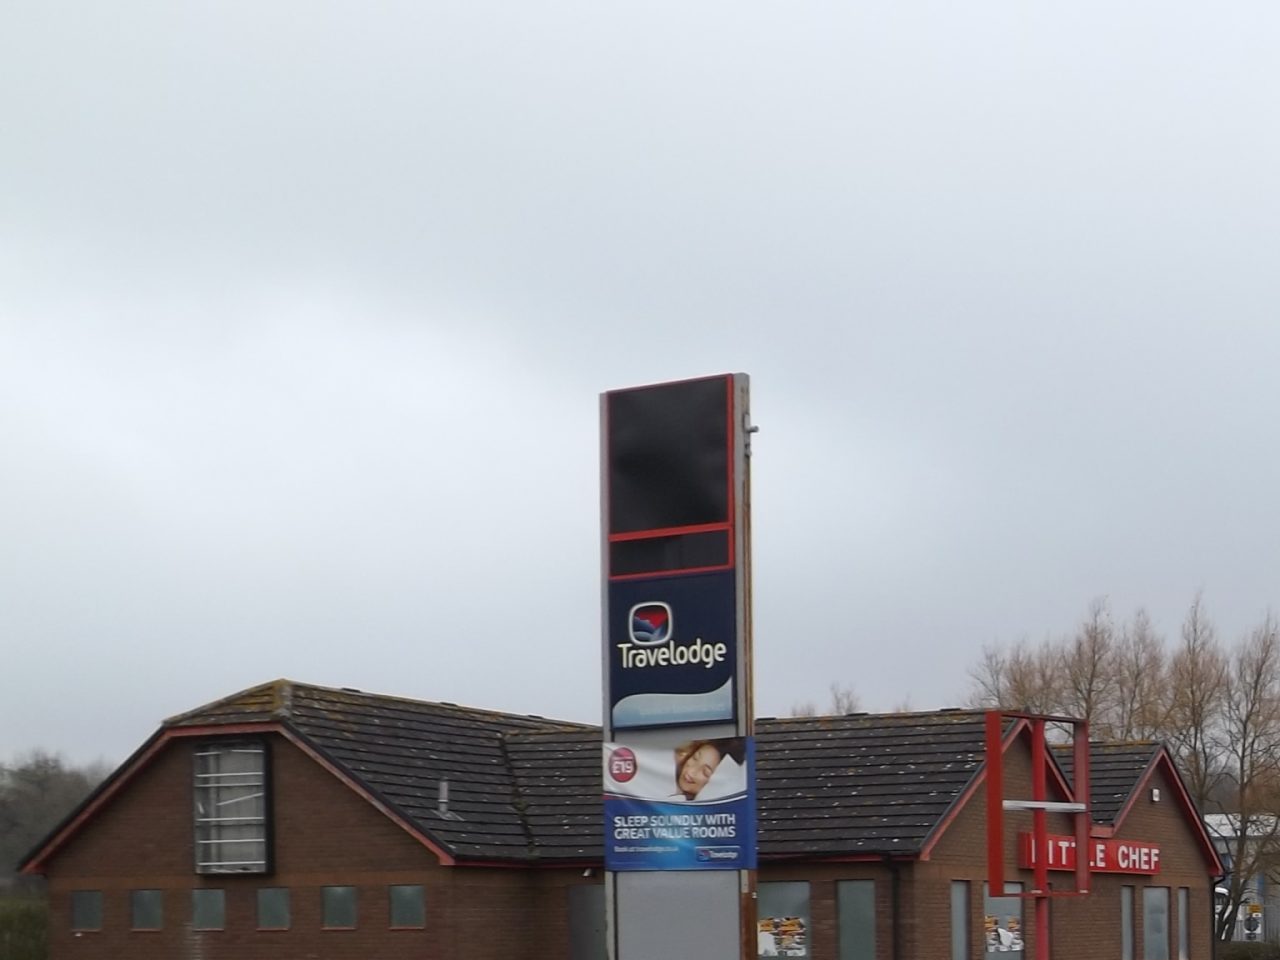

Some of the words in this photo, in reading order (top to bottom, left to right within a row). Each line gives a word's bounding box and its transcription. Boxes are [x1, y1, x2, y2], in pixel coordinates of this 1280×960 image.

[617, 638, 727, 668] Travelodge
[612, 761, 633, 774] £19
[614, 816, 648, 827] SLEEP
[650, 815, 703, 827] SOUNDLY
[705, 814, 736, 825] WITH
[614, 828, 650, 839] GREAT
[653, 827, 690, 838] VALUE
[692, 826, 736, 838] ROOMS
[1031, 839, 1106, 867] ITE
[1118, 845, 1159, 870] CHEF
